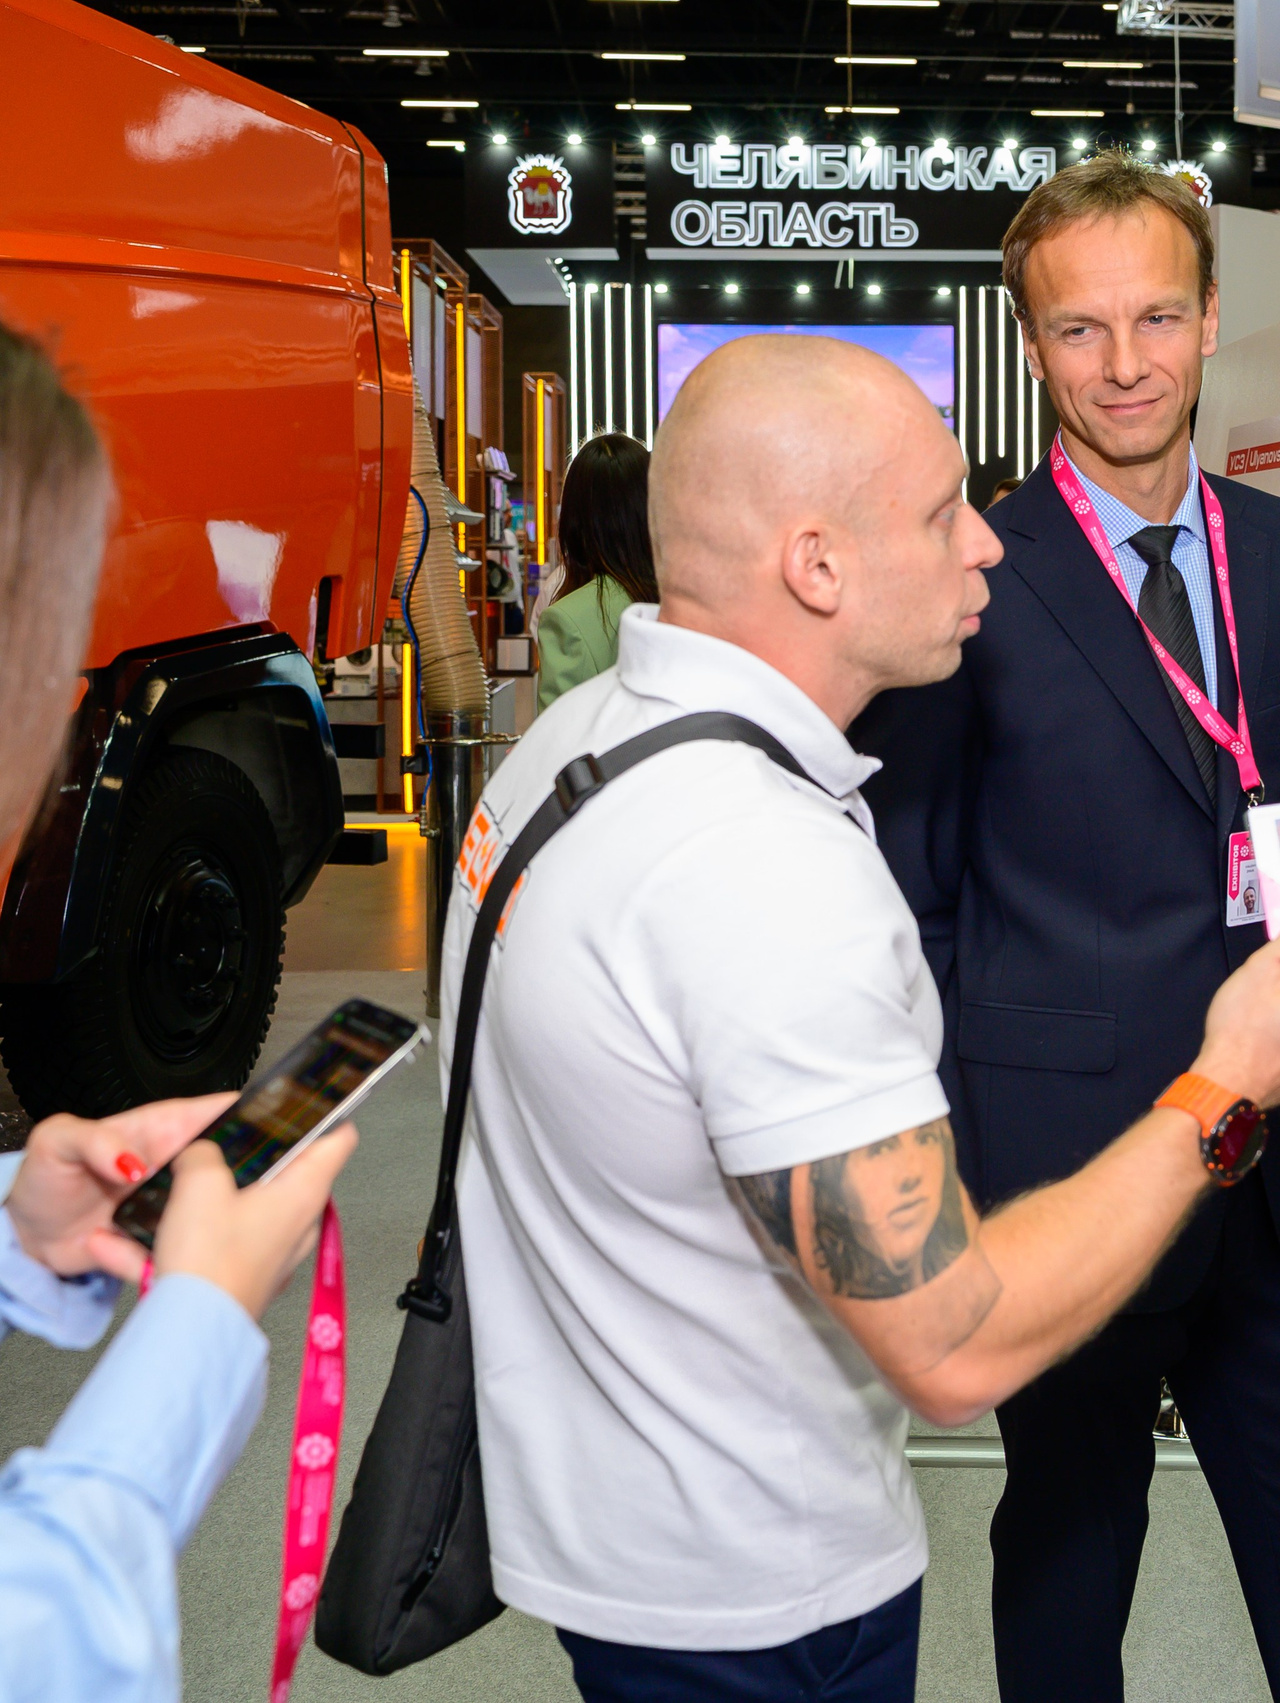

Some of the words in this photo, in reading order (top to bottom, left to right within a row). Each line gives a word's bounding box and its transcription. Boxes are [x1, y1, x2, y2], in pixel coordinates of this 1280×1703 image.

[671, 143, 1057, 191] ЧЕЛЯБИНСКАЯ
[670, 199, 919, 248] ОБЛАСТЬ
[1231, 844, 1240, 892] EXHIBITOR
